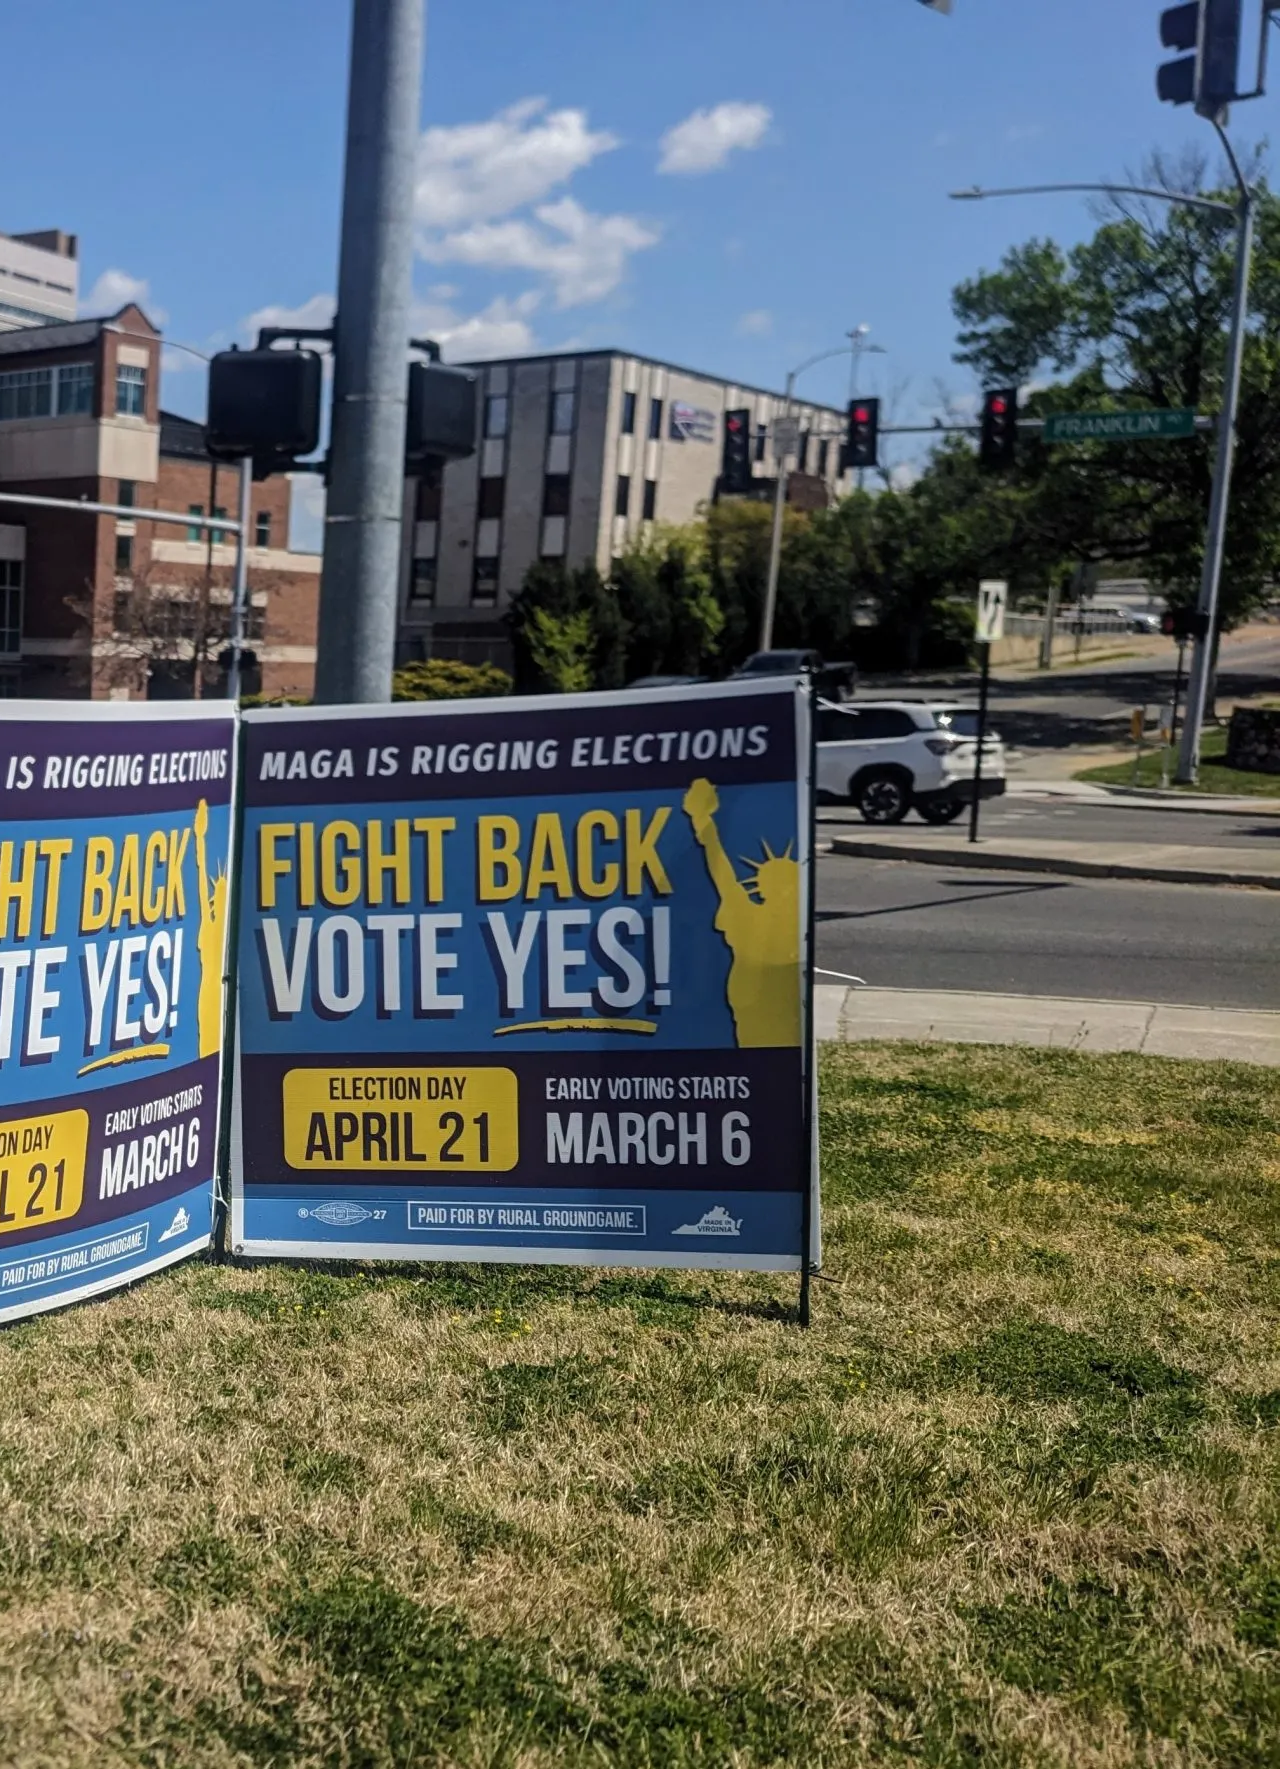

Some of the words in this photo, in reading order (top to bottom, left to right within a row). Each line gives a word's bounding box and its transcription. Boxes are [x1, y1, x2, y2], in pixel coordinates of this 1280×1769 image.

[1053, 415, 1160, 436] FRANKLIN
[6, 756, 36, 790] IS
[43, 754, 143, 789] RIGGING
[148, 749, 228, 785] ELECTIONS
[259, 748, 354, 780] MAGA
[366, 746, 398, 777] IS
[411, 739, 557, 775] RIGGING
[571, 725, 768, 768] ELECTIONS
[82, 828, 191, 931] BACK
[260, 817, 456, 907] FIGHT
[478, 806, 672, 901] BACK
[262, 912, 464, 1013] VOTE
[486, 906, 672, 1010] YES!
[85, 929, 183, 1046] YES!
[105, 1105, 139, 1136] EARLY
[140, 1095, 173, 1126] VOTING
[173, 1085, 203, 1115] STARTS
[329, 1077, 421, 1100] ELECTION
[426, 1077, 467, 1100] DAY
[545, 1077, 602, 1100] EARLY
[607, 1077, 674, 1099] VOTING
[679, 1076, 750, 1098] STARTS
[22, 1125, 54, 1154] DAY
[99, 1129, 181, 1200] MARCH
[186, 1117, 200, 1168] 6
[305, 1111, 427, 1161] APRIL
[438, 1110, 489, 1163] 21
[545, 1111, 707, 1164] MARCH
[721, 1110, 750, 1166] 6
[25, 1158, 66, 1218] 21
[373, 1210, 387, 1219] 27
[418, 1208, 446, 1224] PAID
[450, 1208, 476, 1225] FOR
[478, 1209, 499, 1225] BY
[504, 1209, 540, 1226] RURAL
[544, 1210, 638, 1228] GROUNDGAME.
[2, 1268, 25, 1287] PAID
[27, 1263, 45, 1281] FOR
[47, 1259, 59, 1276] BY
[61, 1251, 89, 1273] RURAL
[91, 1230, 143, 1262] GROUNDGAME.
